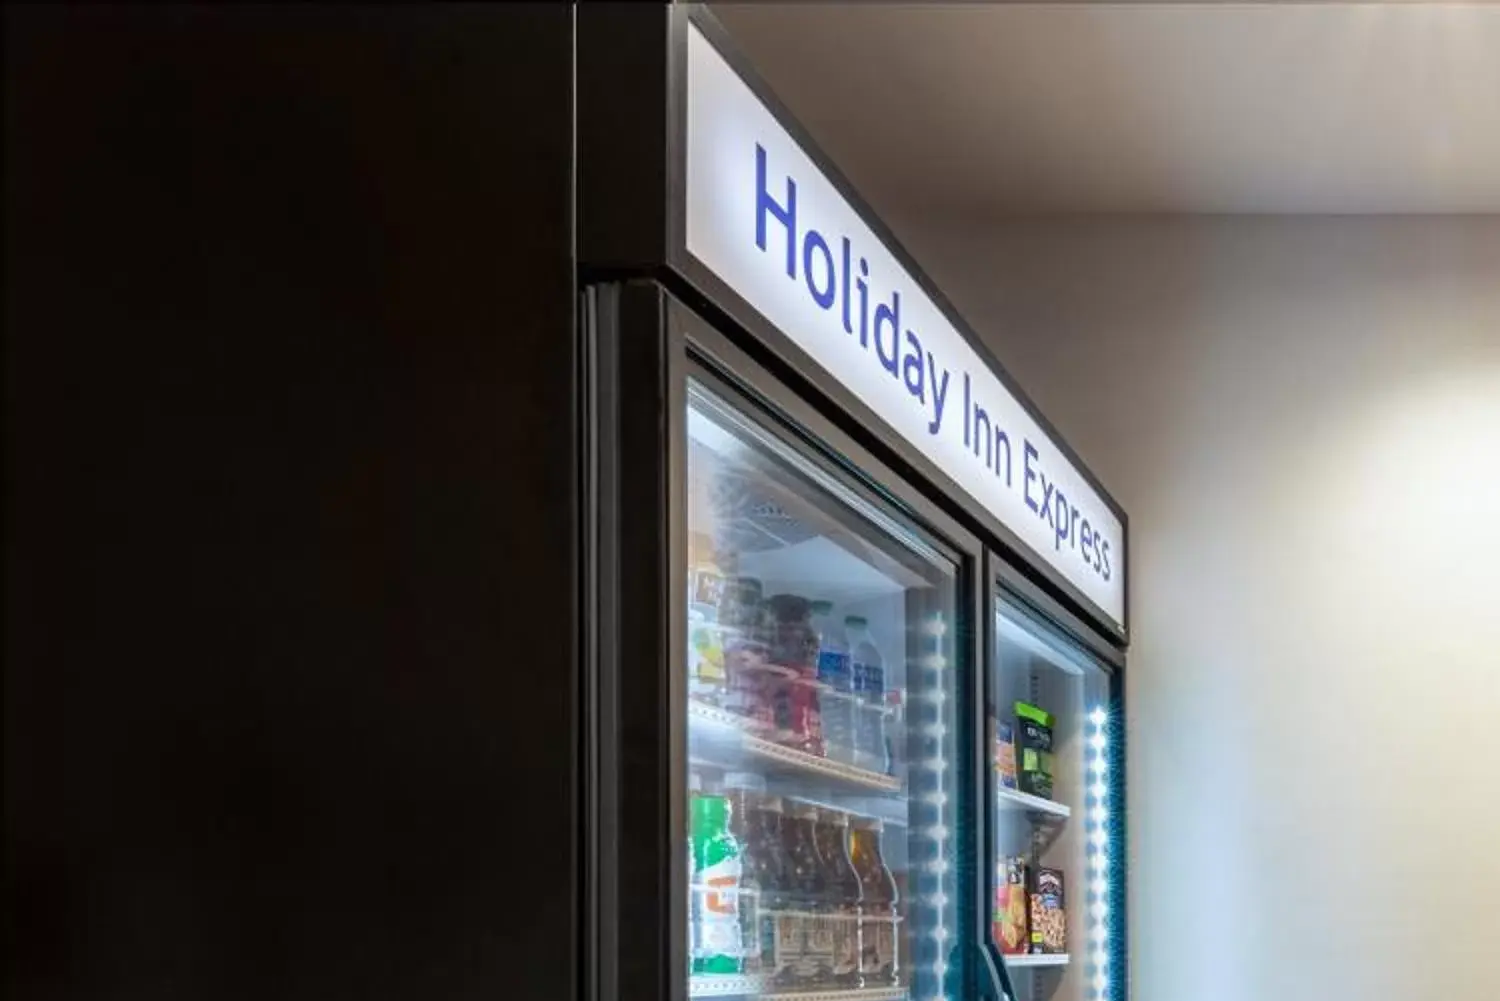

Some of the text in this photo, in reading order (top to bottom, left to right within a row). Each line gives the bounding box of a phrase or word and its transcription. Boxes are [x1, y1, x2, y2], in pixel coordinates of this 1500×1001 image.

[755, 141, 1112, 582] Holiday Inn Express
